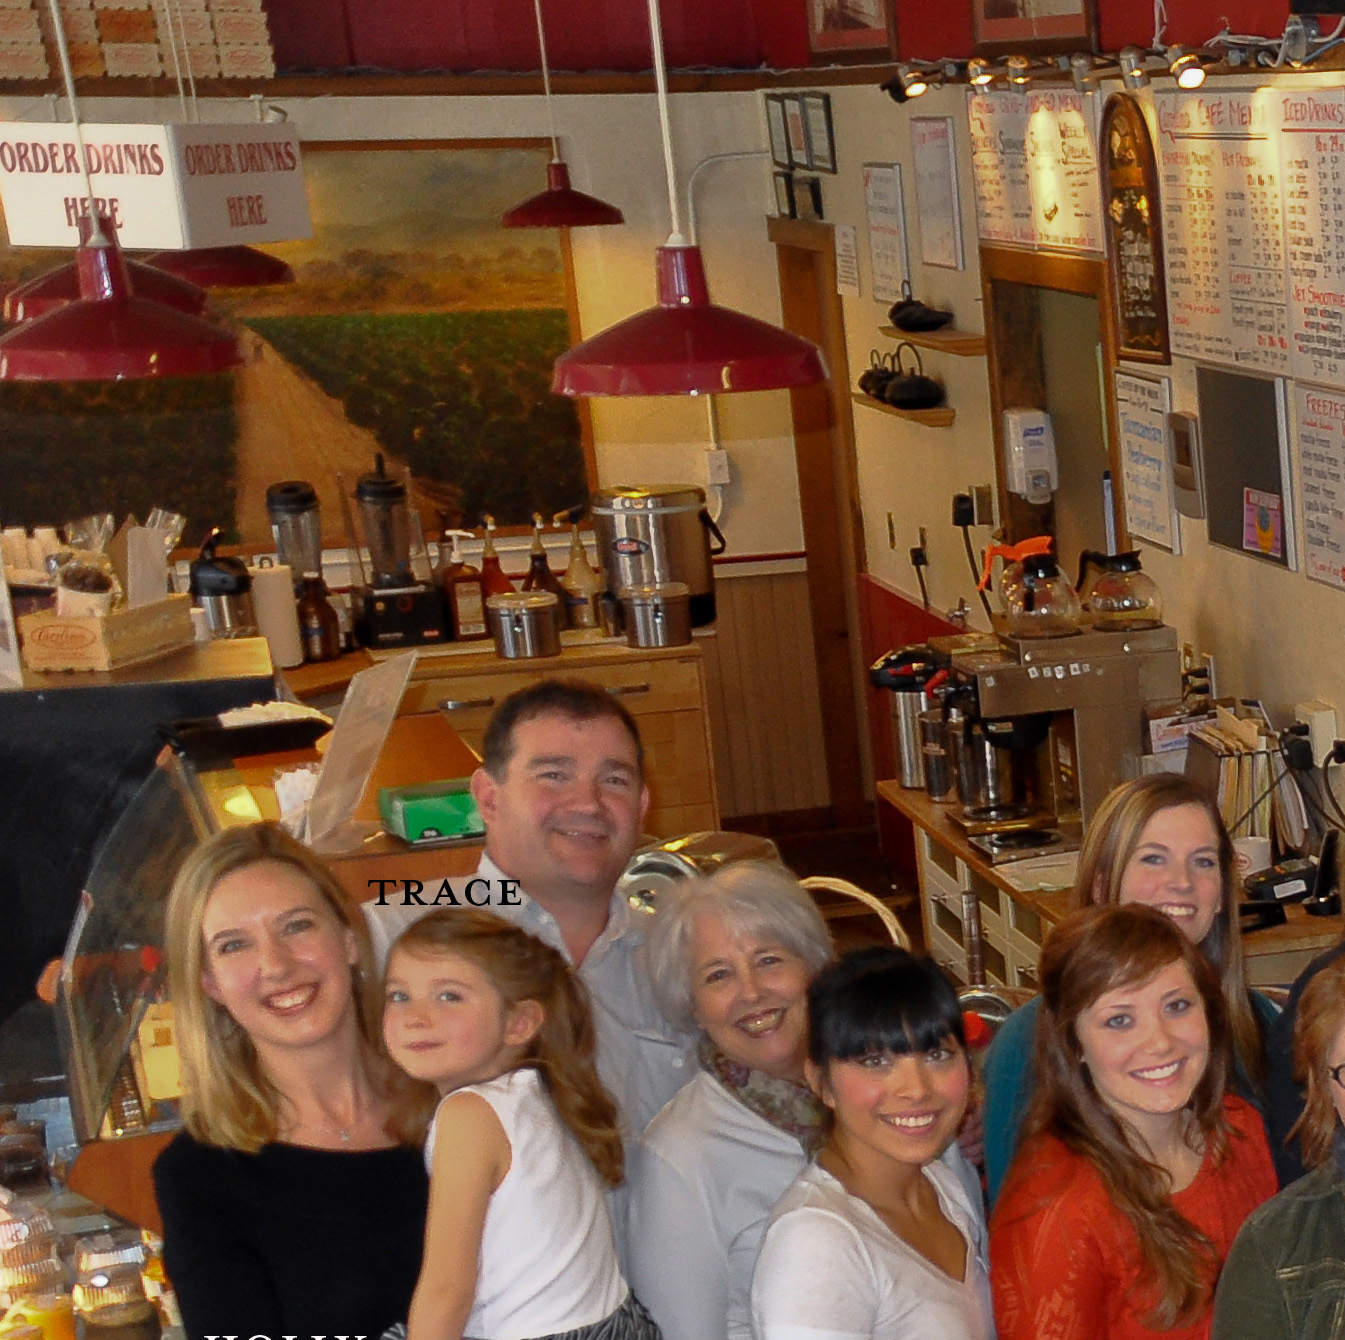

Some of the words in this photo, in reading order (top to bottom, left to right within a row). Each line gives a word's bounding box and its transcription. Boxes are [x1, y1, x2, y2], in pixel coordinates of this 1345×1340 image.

[0, 141, 81, 174] ORDER
[83, 143, 165, 176] DRINKS
[185, 144, 235, 176] ORDER
[236, 141, 297, 174] DRINKS
[226, 195, 268, 228] HERE
